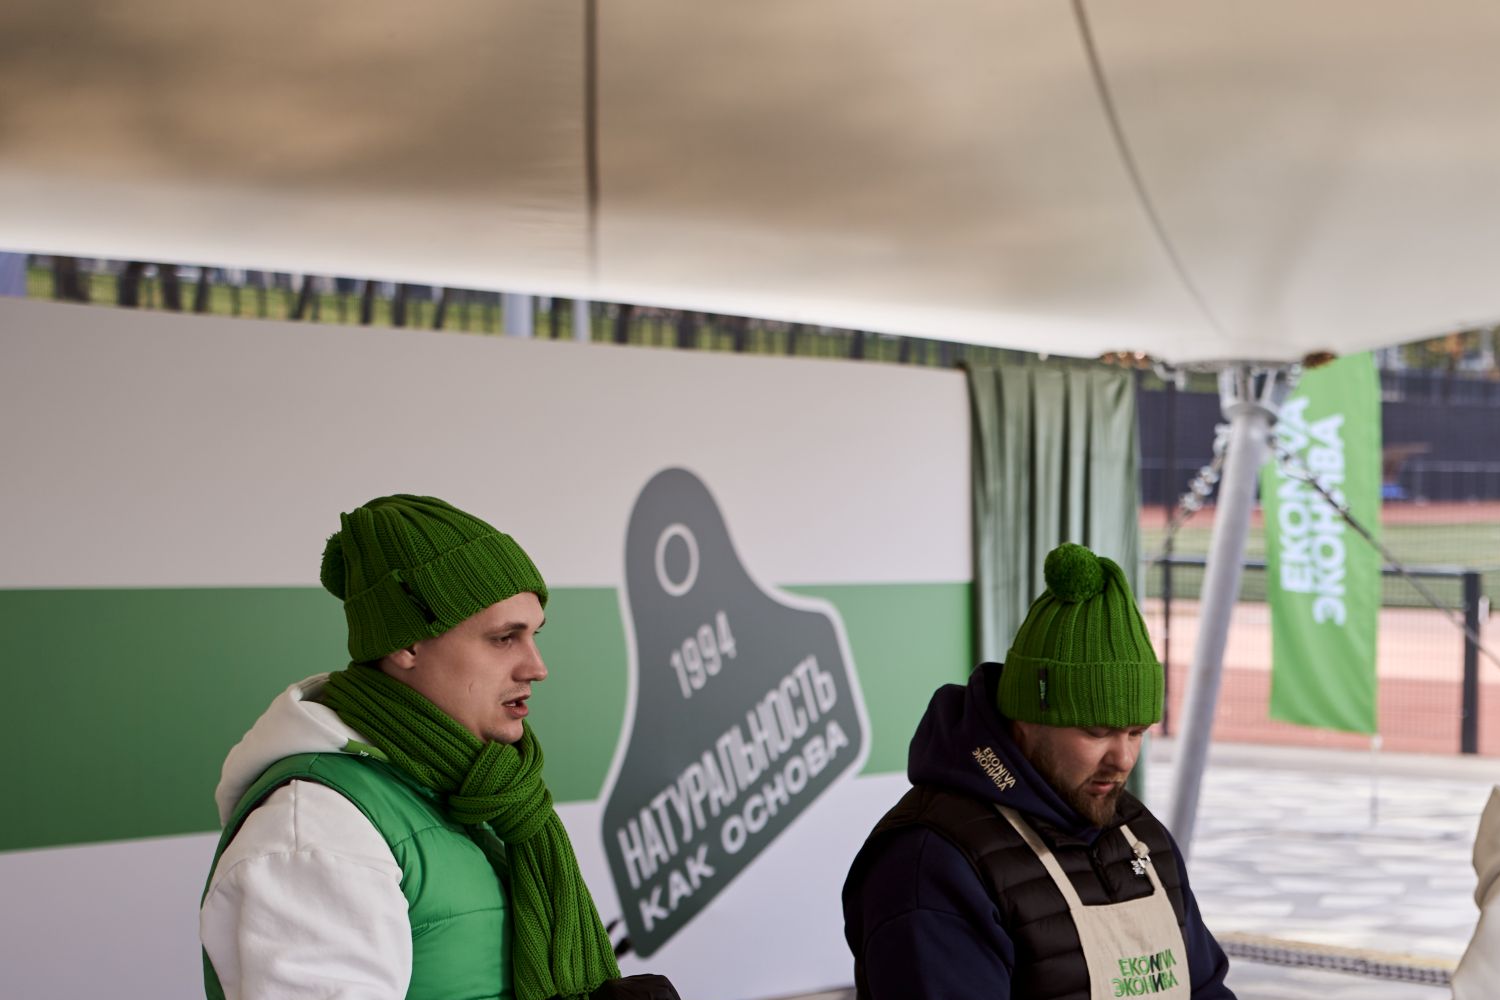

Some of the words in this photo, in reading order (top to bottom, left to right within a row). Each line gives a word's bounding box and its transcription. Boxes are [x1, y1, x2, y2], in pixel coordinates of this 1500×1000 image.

[671, 611, 735, 698] 1994
[617, 655, 838, 888] НАТУРАЛЬНОСТЬ
[972, 747, 1007, 791] ЭКОНИВА
[983, 747, 1016, 788] EKONIVA
[638, 843, 718, 932] КАК
[720, 720, 849, 855] ОСНОВА
[1111, 969, 1179, 998] ЭКОНИВА
[1118, 948, 1177, 977] EKONIVA
